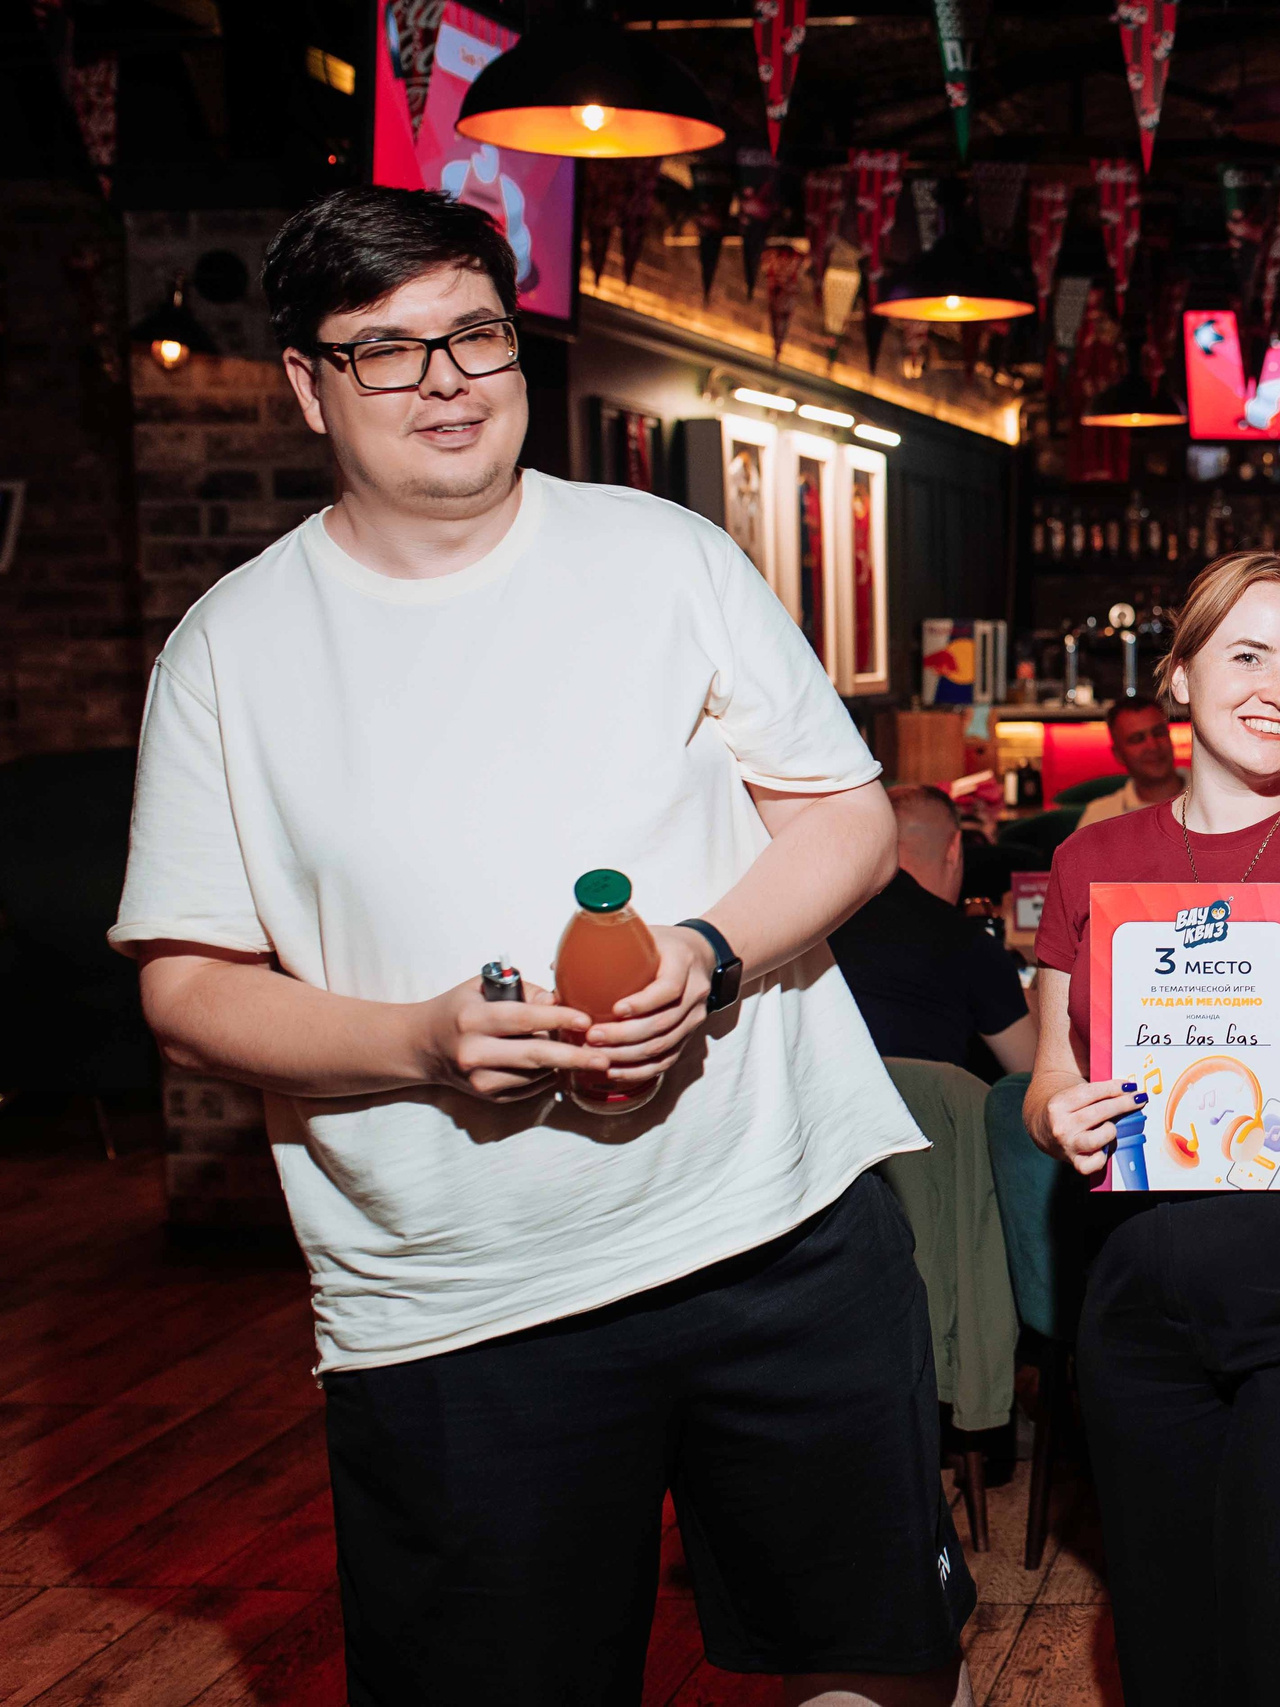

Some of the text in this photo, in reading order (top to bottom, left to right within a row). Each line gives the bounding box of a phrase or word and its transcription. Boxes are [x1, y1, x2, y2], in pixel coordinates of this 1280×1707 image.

[1175, 906, 1210, 931] ВАУ
[1183, 920, 1226, 945] КВИЗ
[1154, 947, 1252, 975] 3 МЕСТО
[1141, 995, 1263, 1007] УГАДАЙ МЕЛОДИЮ
[1160, 984, 1231, 993] ТЕМАТИЧЕСКОЙ
[1233, 985, 1256, 993] ИГРЕ
